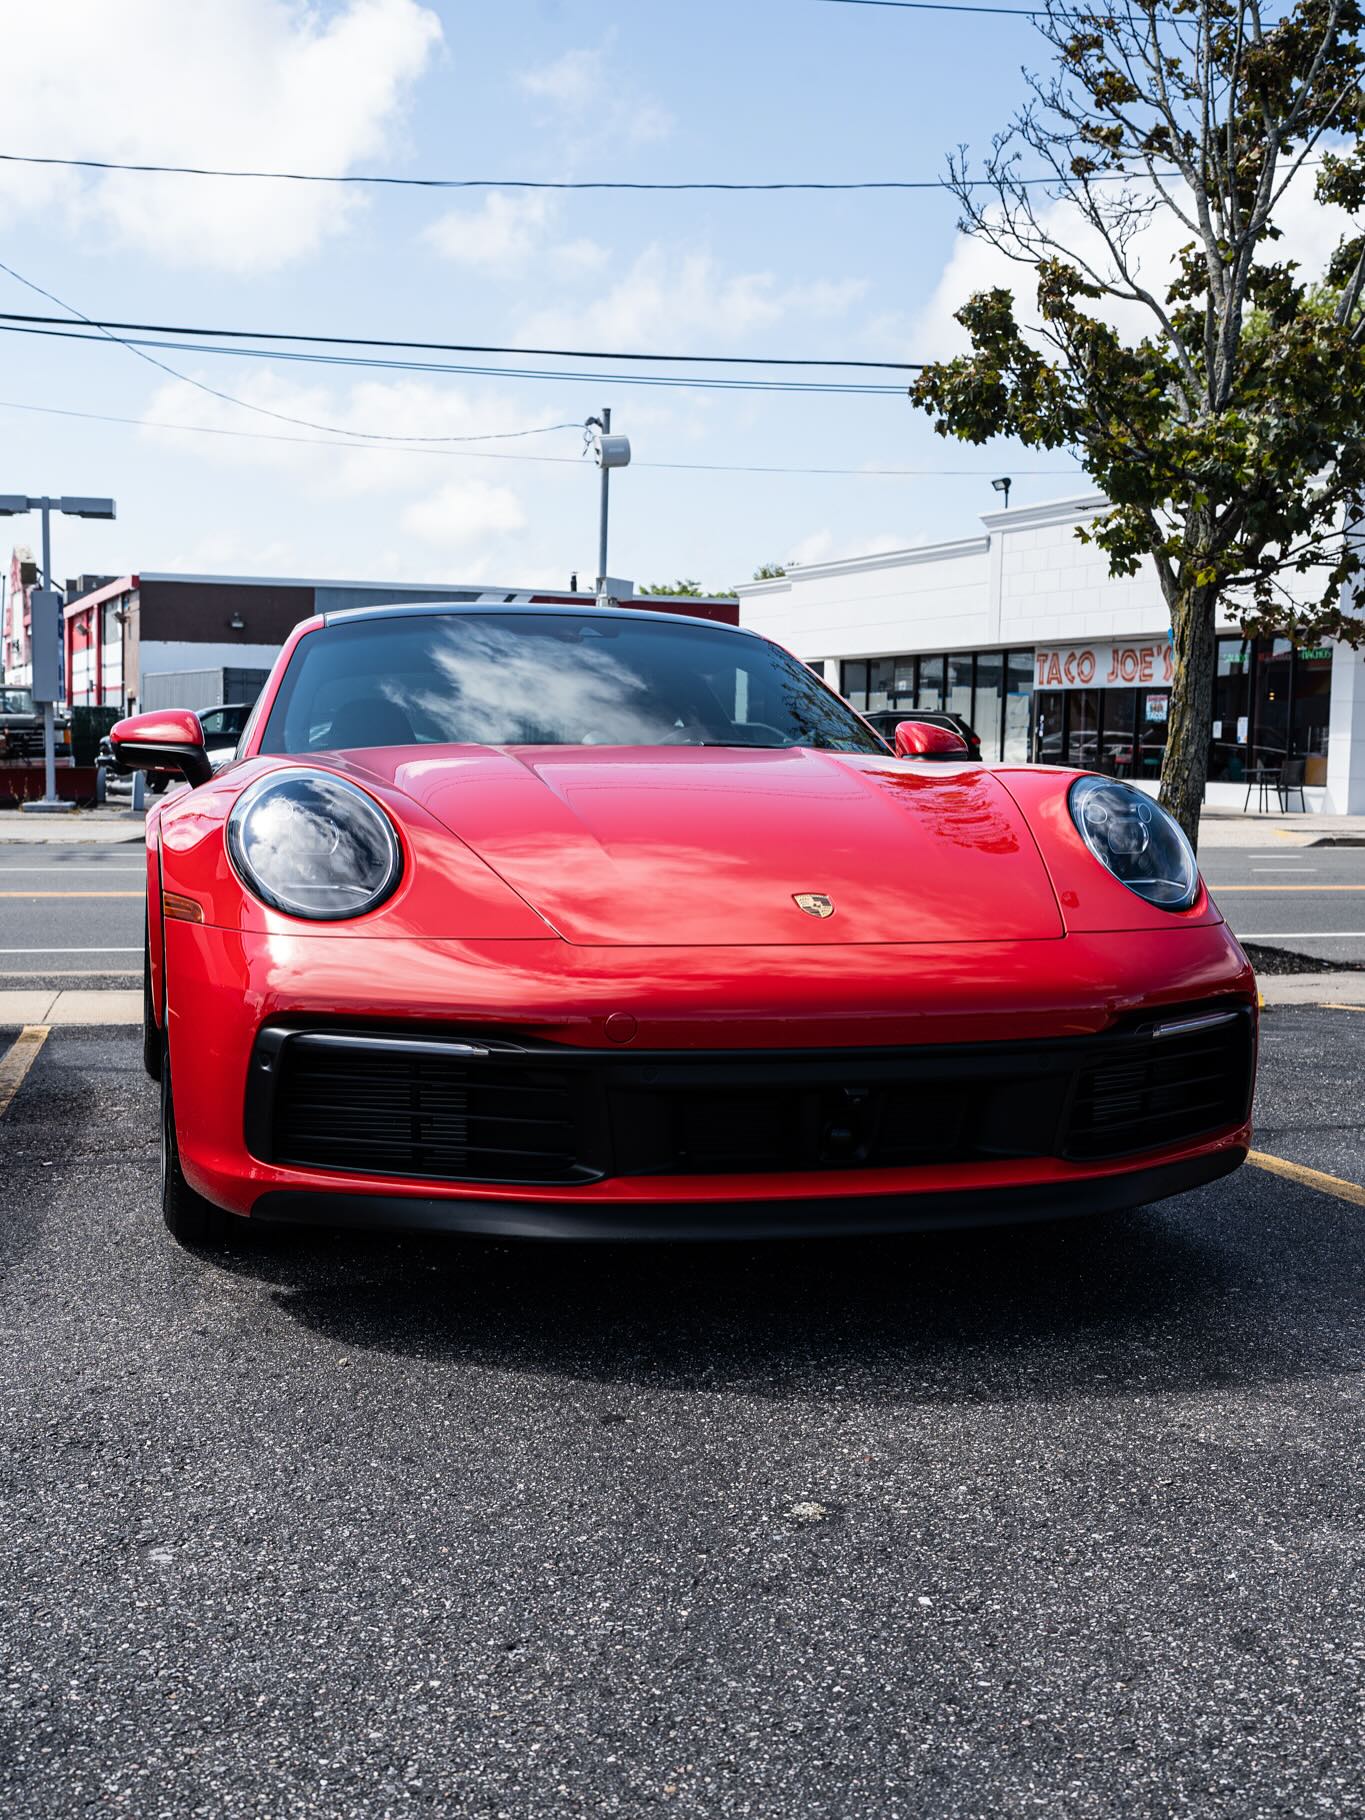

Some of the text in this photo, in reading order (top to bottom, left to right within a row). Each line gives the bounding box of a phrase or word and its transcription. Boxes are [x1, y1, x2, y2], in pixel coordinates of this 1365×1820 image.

[1036, 644, 1174, 686] TACO JOE'S
[1302, 648, 1332, 660] NACHOS
